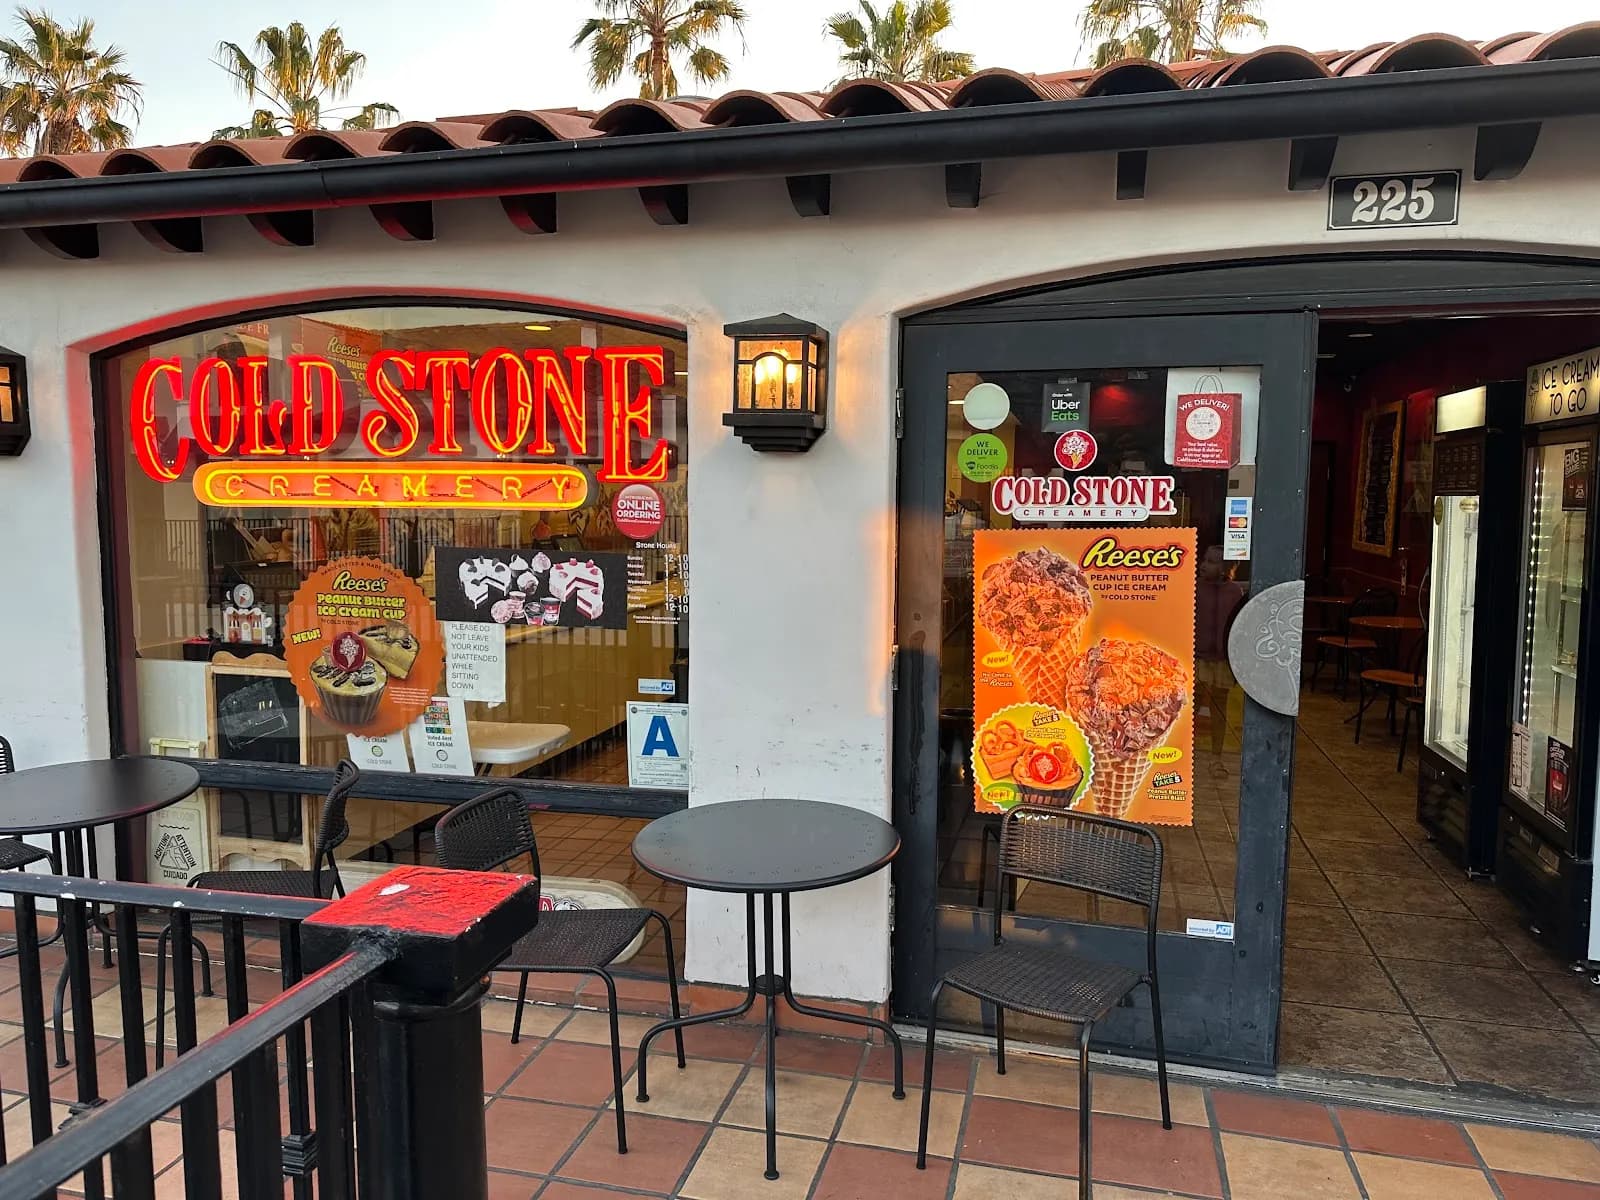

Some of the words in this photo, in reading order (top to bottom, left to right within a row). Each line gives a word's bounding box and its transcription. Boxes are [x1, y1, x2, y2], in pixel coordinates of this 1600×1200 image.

[1352, 177, 1434, 222] 225
[1541, 365, 1557, 391] ICE
[1562, 356, 1600, 386] CREAM
[1051, 399, 1080, 410] Uber
[1179, 401, 1193, 411] WE
[1194, 398, 1230, 411] DELIVER!
[1550, 393, 1562, 416] TO
[1568, 387, 1587, 412] GO
[130, 354, 344, 483] COLD
[361, 345, 667, 483] STONE
[1051, 410, 1080, 421] Eats
[1565, 450, 1580, 467] BIG
[226, 474, 568, 500] CREAMERY
[994, 478, 1068, 512] COLD
[1074, 478, 1173, 512] STONE
[617, 499, 660, 511] ONLINE
[616, 509, 661, 520] ORDERING
[1023, 509, 1138, 517] CREAMERY
[1083, 537, 1183, 567] Reese's
[333, 570, 388, 592] Reese's
[1090, 574, 1129, 582] PEANUT
[1131, 574, 1169, 582] BUTTER
[452, 623, 479, 631] PLEASE
[291, 628, 321, 645] NEW!
[468, 634, 489, 642] LEAVE
[452, 643, 472, 651] YOUR
[473, 644, 489, 652] KIDS
[452, 653, 498, 662] UNATTENDED
[986, 655, 1009, 665] New!
[452, 663, 473, 671] WHILE
[452, 672, 479, 680] SITTING
[452, 682, 474, 690] DOWN
[641, 715, 681, 758] A
[1153, 751, 1177, 760] New!
[1155, 777, 1174, 787] TAKE
[1174, 775, 1181, 783] 5
[154, 833, 170, 860] ACHTUNG
[176, 834, 197, 867] ATTENTION
[163, 870, 188, 880] CUIDADO
